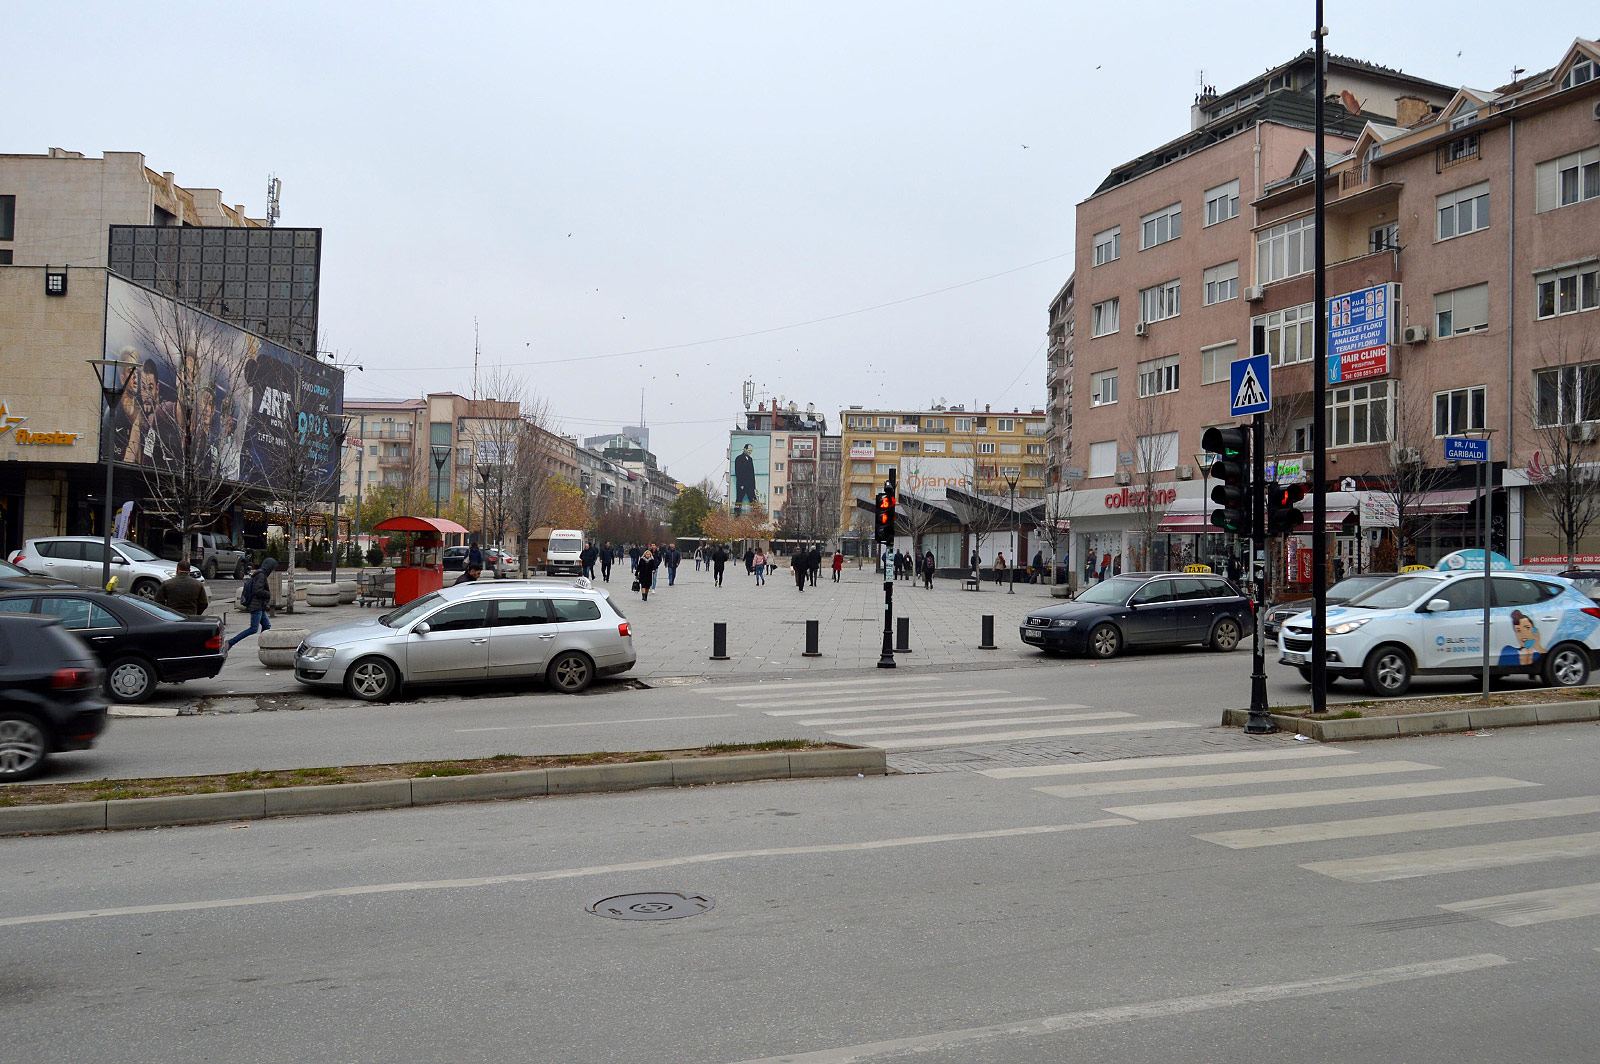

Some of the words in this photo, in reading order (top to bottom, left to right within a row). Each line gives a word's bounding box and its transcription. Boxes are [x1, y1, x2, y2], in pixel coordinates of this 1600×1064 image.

[1352, 305, 1365, 314] HAIR
[1363, 321, 1383, 331] FLOKU
[1334, 334, 1359, 346] ANALIZE
[1360, 330, 1381, 340] FLOKU
[1335, 342, 1357, 353] TERAPI
[1357, 338, 1378, 348] FLOKU
[1341, 353, 1359, 365] HAIR
[1360, 347, 1386, 360] CLINIC
[258, 386, 291, 419] ART
[16, 429, 77, 446] fivestar
[1448, 449, 1484, 459] GARIBALDI
[906, 475, 967, 491] Orange
[1540, 555, 1562, 563] Contact
[1562, 554, 1582, 562] Cter
